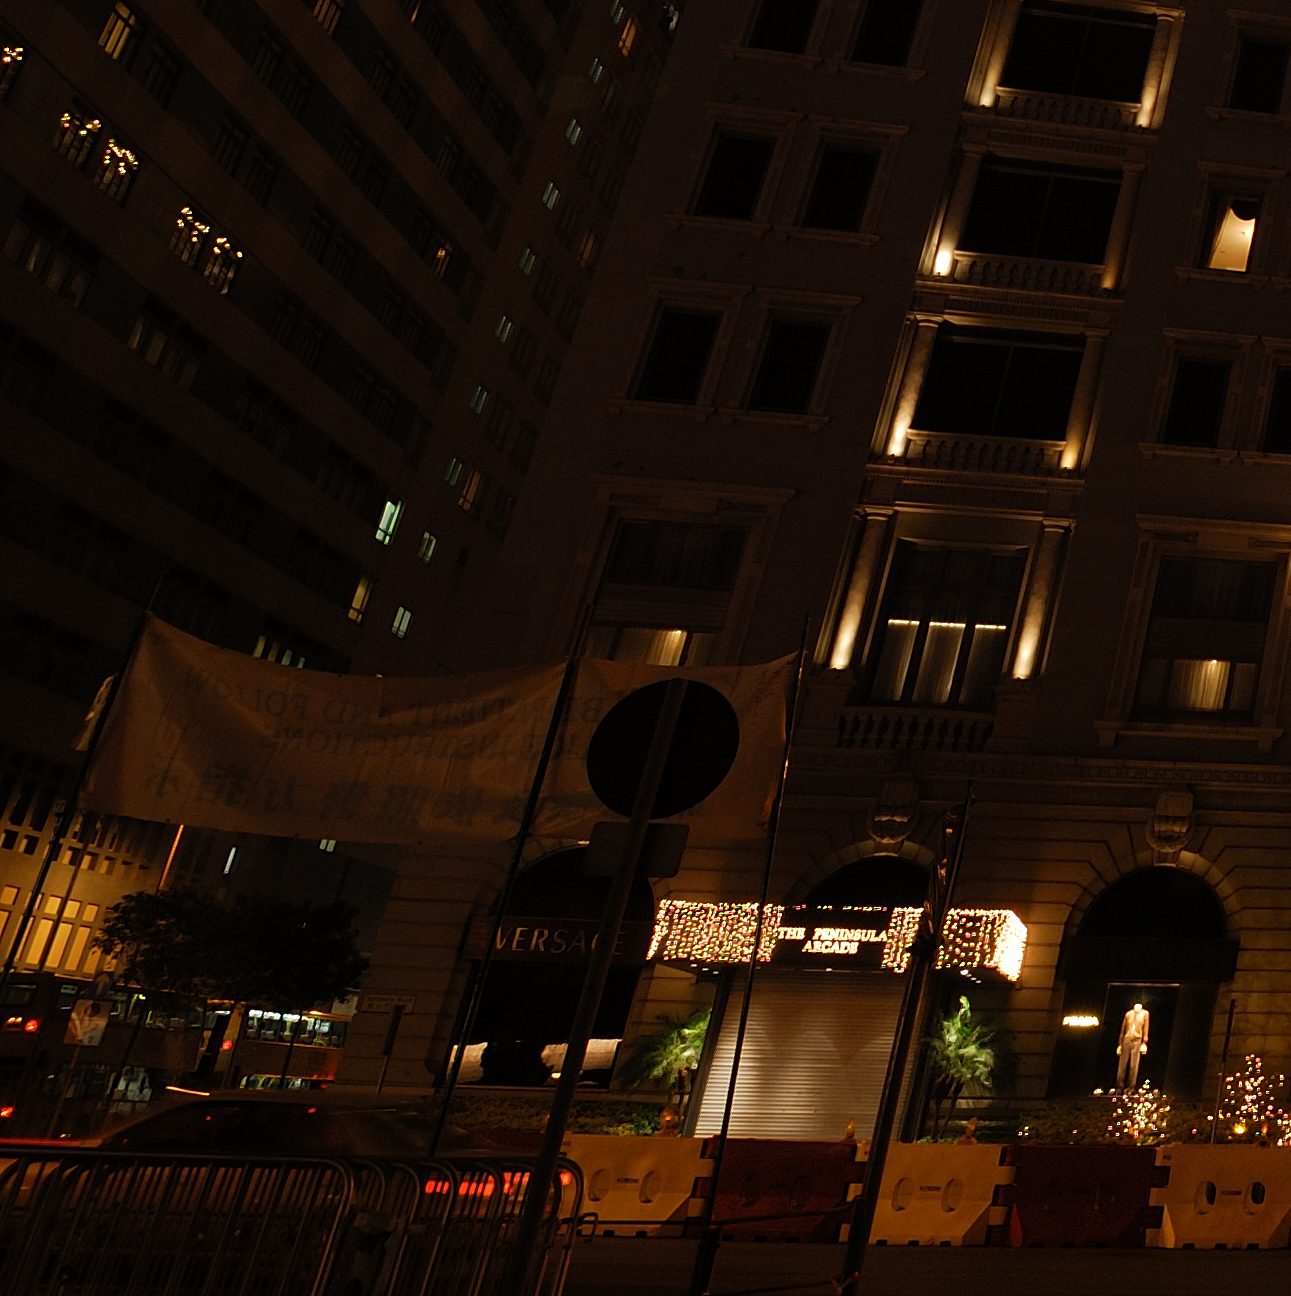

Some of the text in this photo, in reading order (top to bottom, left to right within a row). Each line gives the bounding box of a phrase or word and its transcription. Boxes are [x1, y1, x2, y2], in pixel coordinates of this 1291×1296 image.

[778, 926, 888, 942] THE PENINSULA
[801, 940, 859, 954] ARCADE
